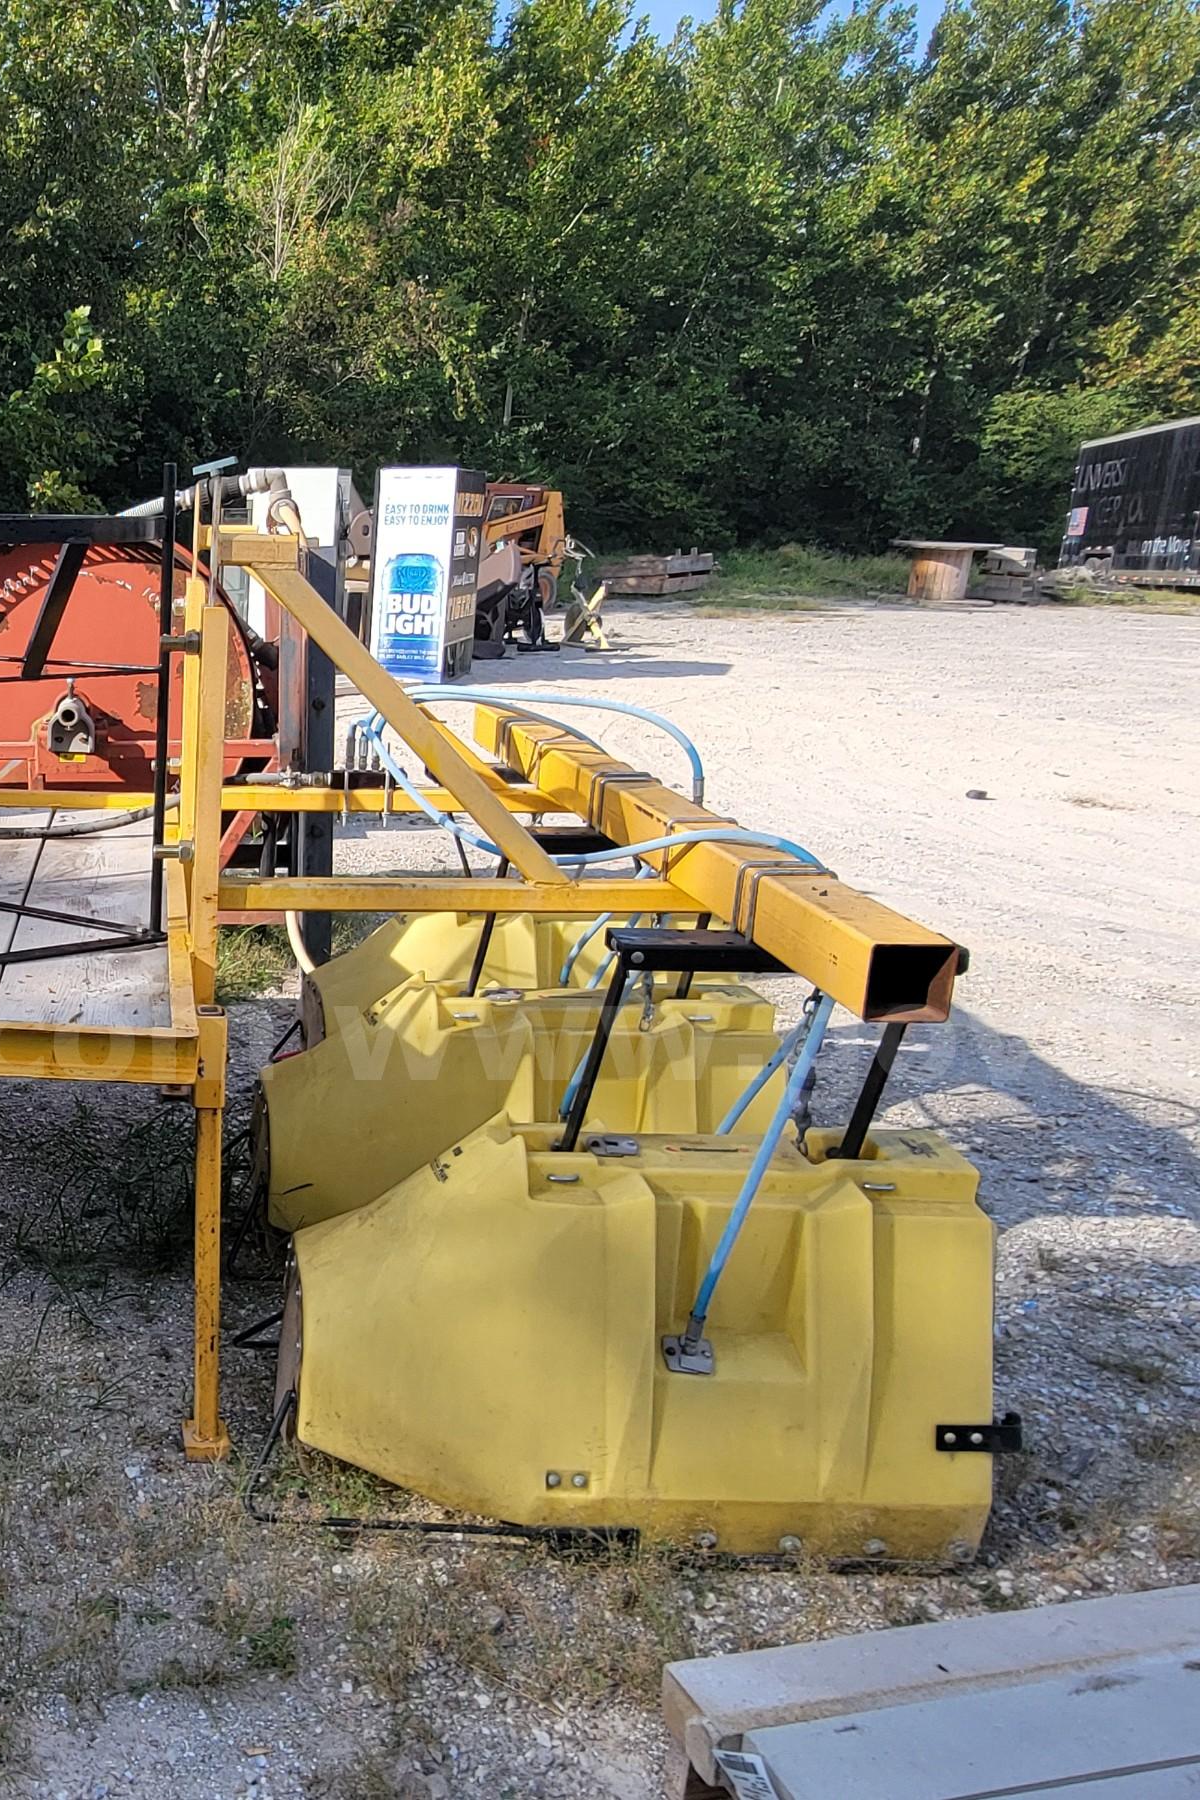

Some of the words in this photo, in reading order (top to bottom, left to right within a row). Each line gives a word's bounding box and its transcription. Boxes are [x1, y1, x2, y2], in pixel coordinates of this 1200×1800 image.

[385, 504, 407, 514] EASY
[409, 504, 420, 514] TO
[422, 504, 450, 514] DRINK
[384, 515, 406, 525] EASY
[408, 515, 420, 525] TO
[421, 515, 449, 525] ENJOY
[384, 593, 437, 614] BUD
[383, 614, 440, 635] LIGHT
